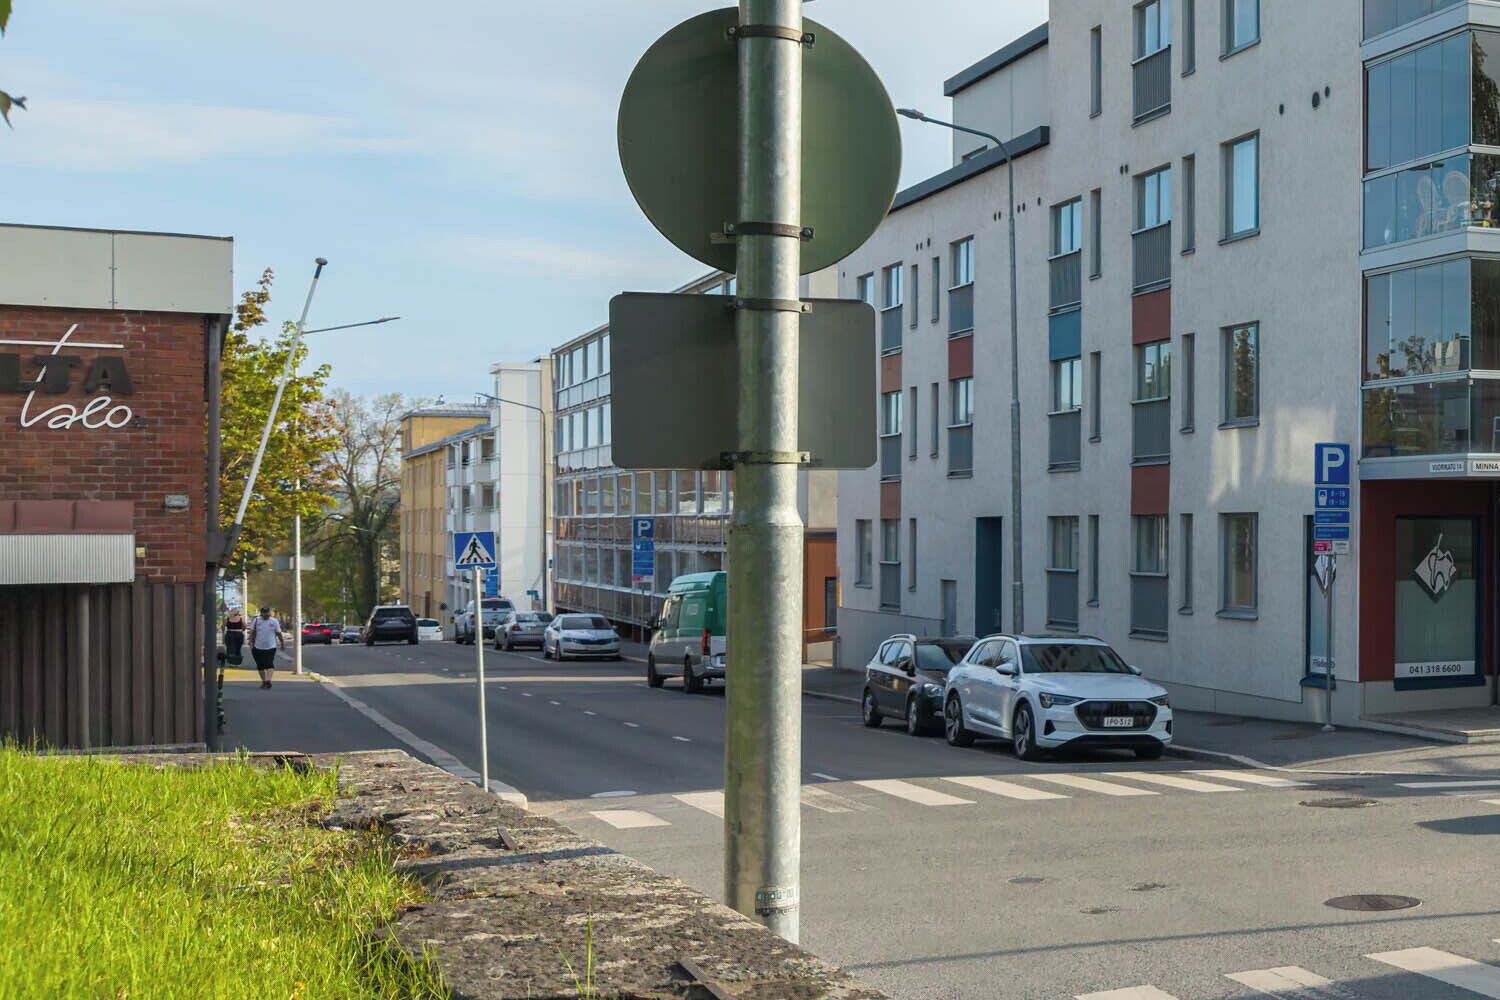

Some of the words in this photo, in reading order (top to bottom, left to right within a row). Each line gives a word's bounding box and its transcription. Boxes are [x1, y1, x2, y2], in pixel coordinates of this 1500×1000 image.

[1322, 447, 1345, 482] P
[1475, 462, 1499, 471] MINNA
[637, 520, 652, 537] P
[1409, 665, 1424, 674] 041
[1425, 665, 1441, 674] 318
[1442, 664, 1462, 673] 6600
